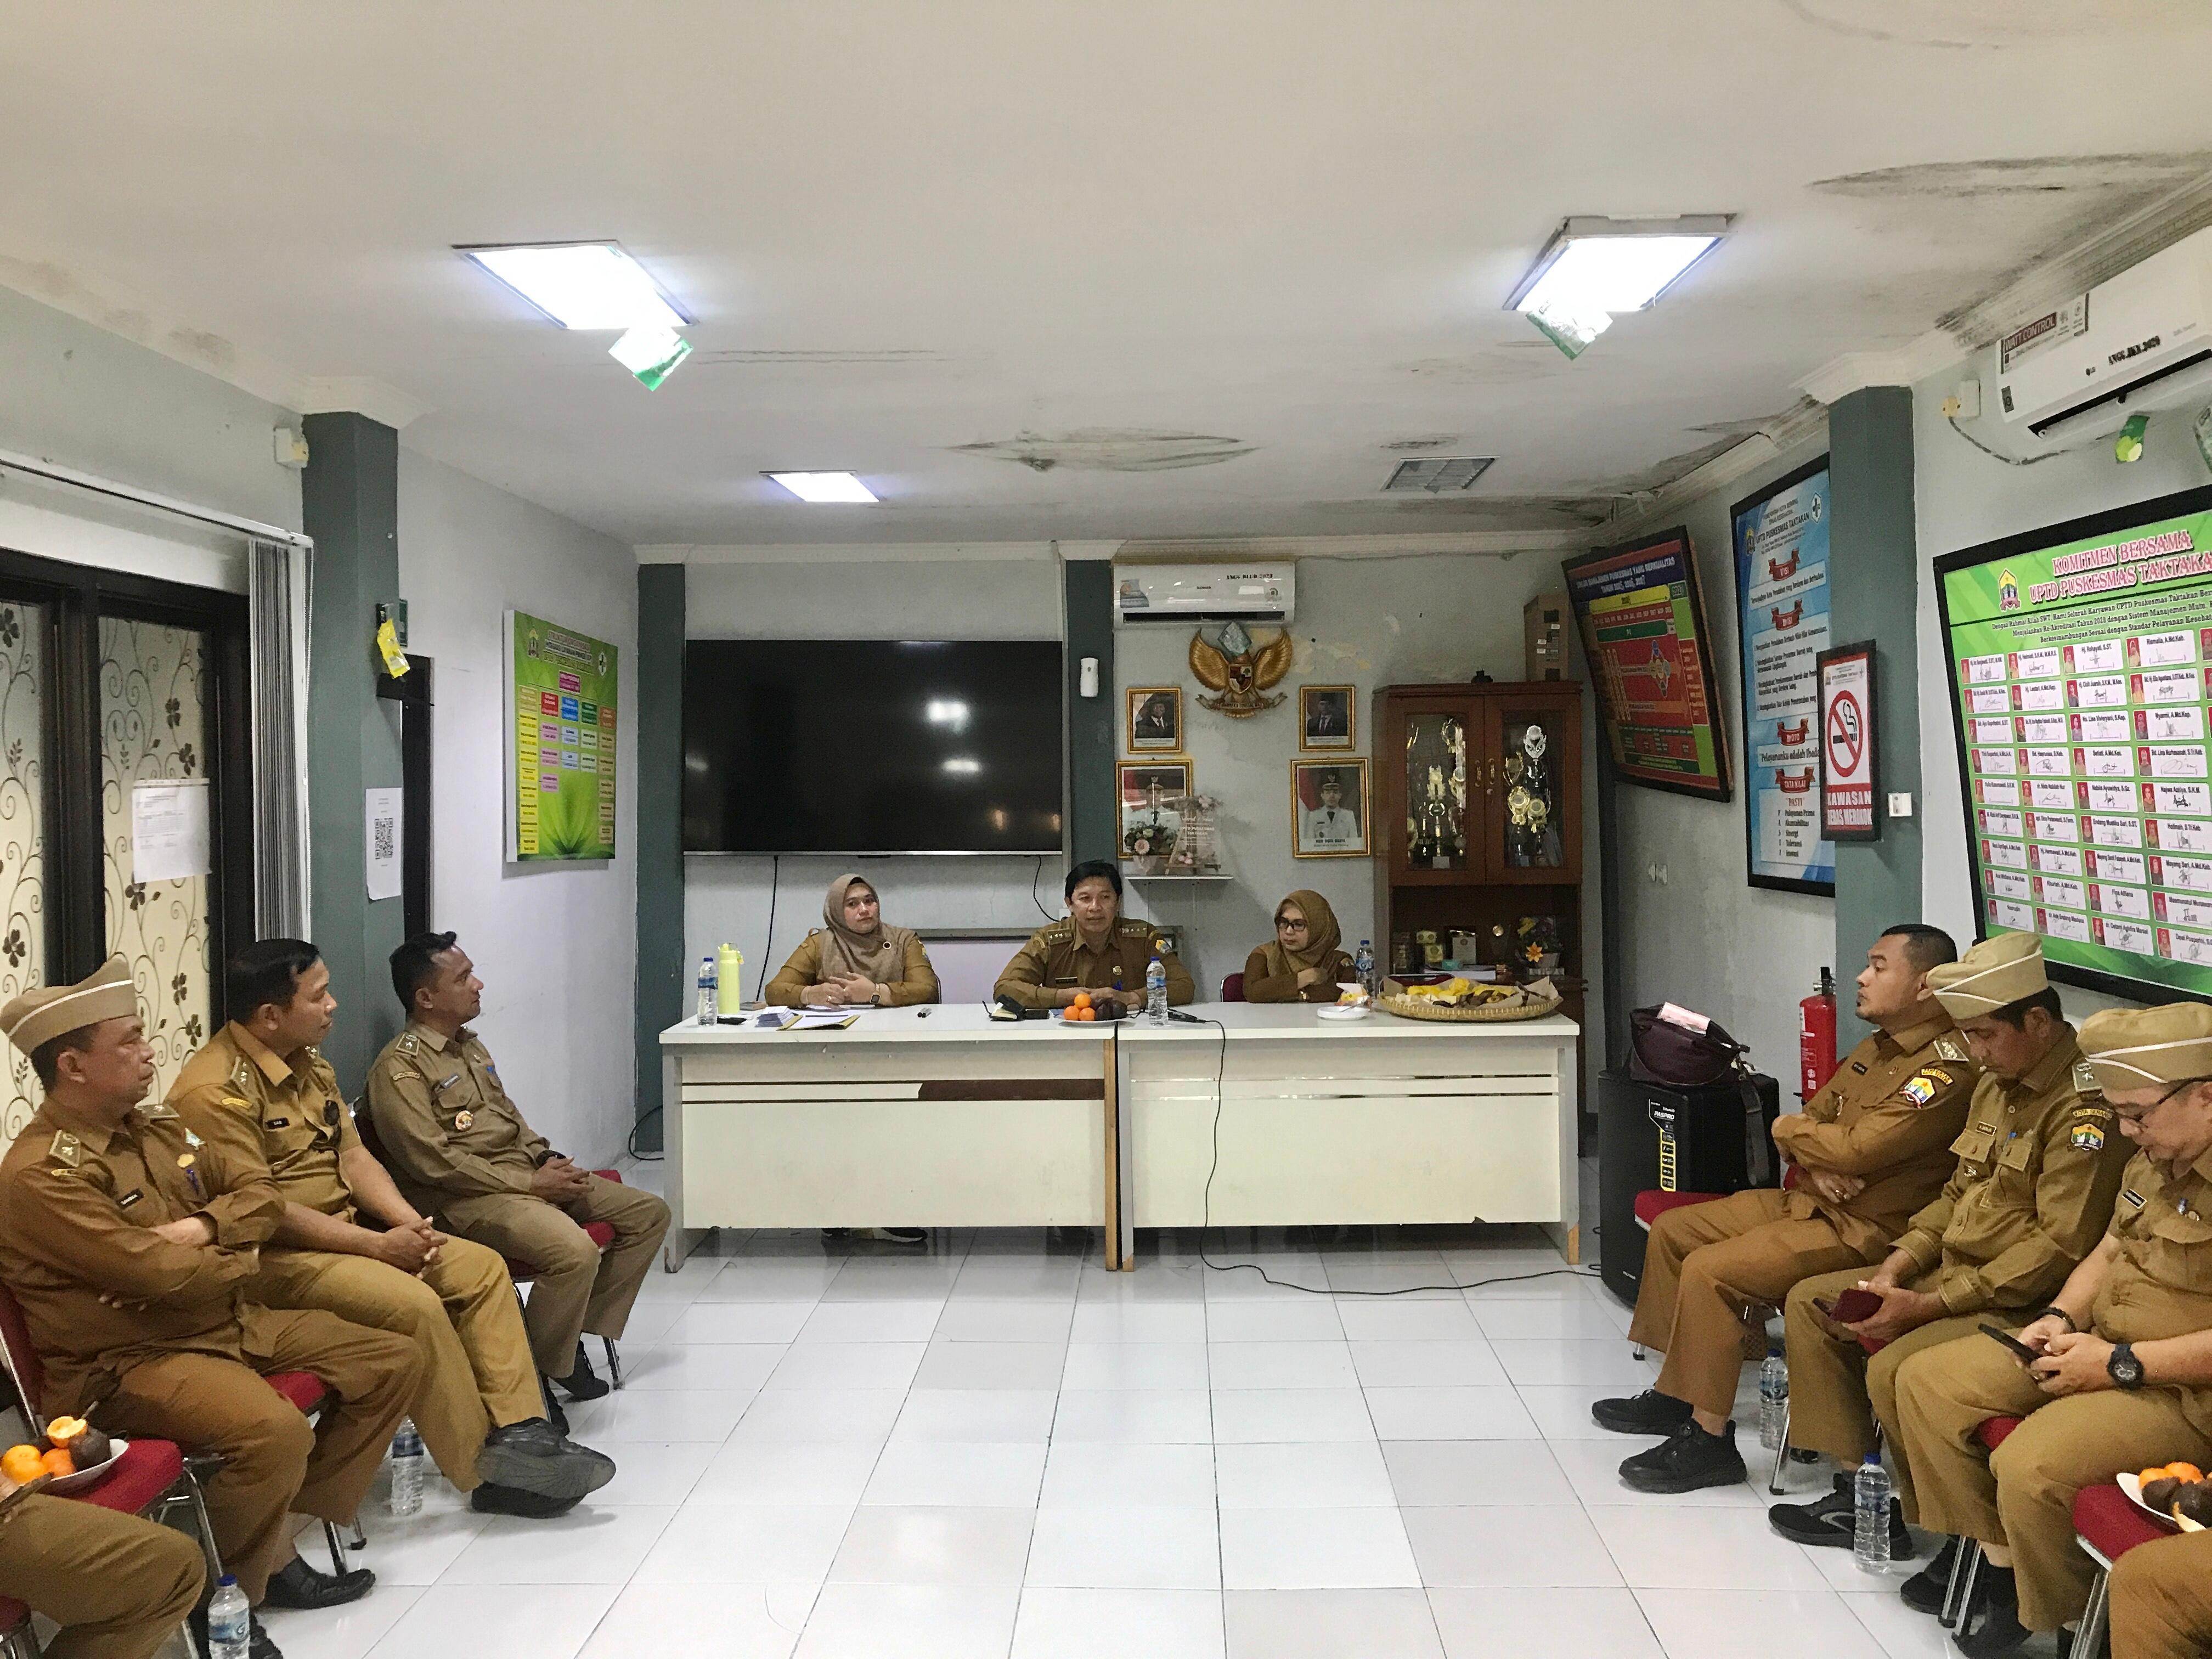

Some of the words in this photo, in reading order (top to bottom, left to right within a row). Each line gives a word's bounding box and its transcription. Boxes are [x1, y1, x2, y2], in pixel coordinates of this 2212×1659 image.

[2005, 334, 2022, 351] WATT
[2023, 317, 2055, 340] CONTROL
[1766, 521, 1788, 539] PUSKESMAS
[1789, 512, 1809, 528] TAKTAKAN
[2052, 545, 2118, 576] KOMITMEN
[2119, 530, 2193, 562] BERSAMA
[2029, 580, 2059, 602] UPTD
[2060, 566, 2137, 597] PUSKESMAS
[2088, 605, 2115, 614] Karyawan
[2117, 601, 2132, 610] UPTD
[2134, 597, 2168, 607] Puskesmas
[2169, 592, 2198, 602] Taktakan
[2012, 627, 2042, 637] Menjalankan
[2043, 621, 2076, 632] Re-Akreditasi
[2107, 614, 2128, 623] dengan
[2129, 611, 2148, 619] Sistem
[2150, 606, 2186, 616] Manajemen
[2089, 628, 2106, 637] Sesuai
[2107, 625, 2128, 634] dengan
[2129, 622, 2151, 631] Standar
[2152, 618, 2183, 628] Pelayanan
[1786, 733, 1799, 742] MOTO
[1790, 748, 1805, 759] adalah
[1784, 780, 1794, 788] TATA
[1795, 780, 1806, 788] NILAI
[1827, 791, 1871, 806] KAWASAN
[1654, 1110, 1675, 1120] PASPRO
